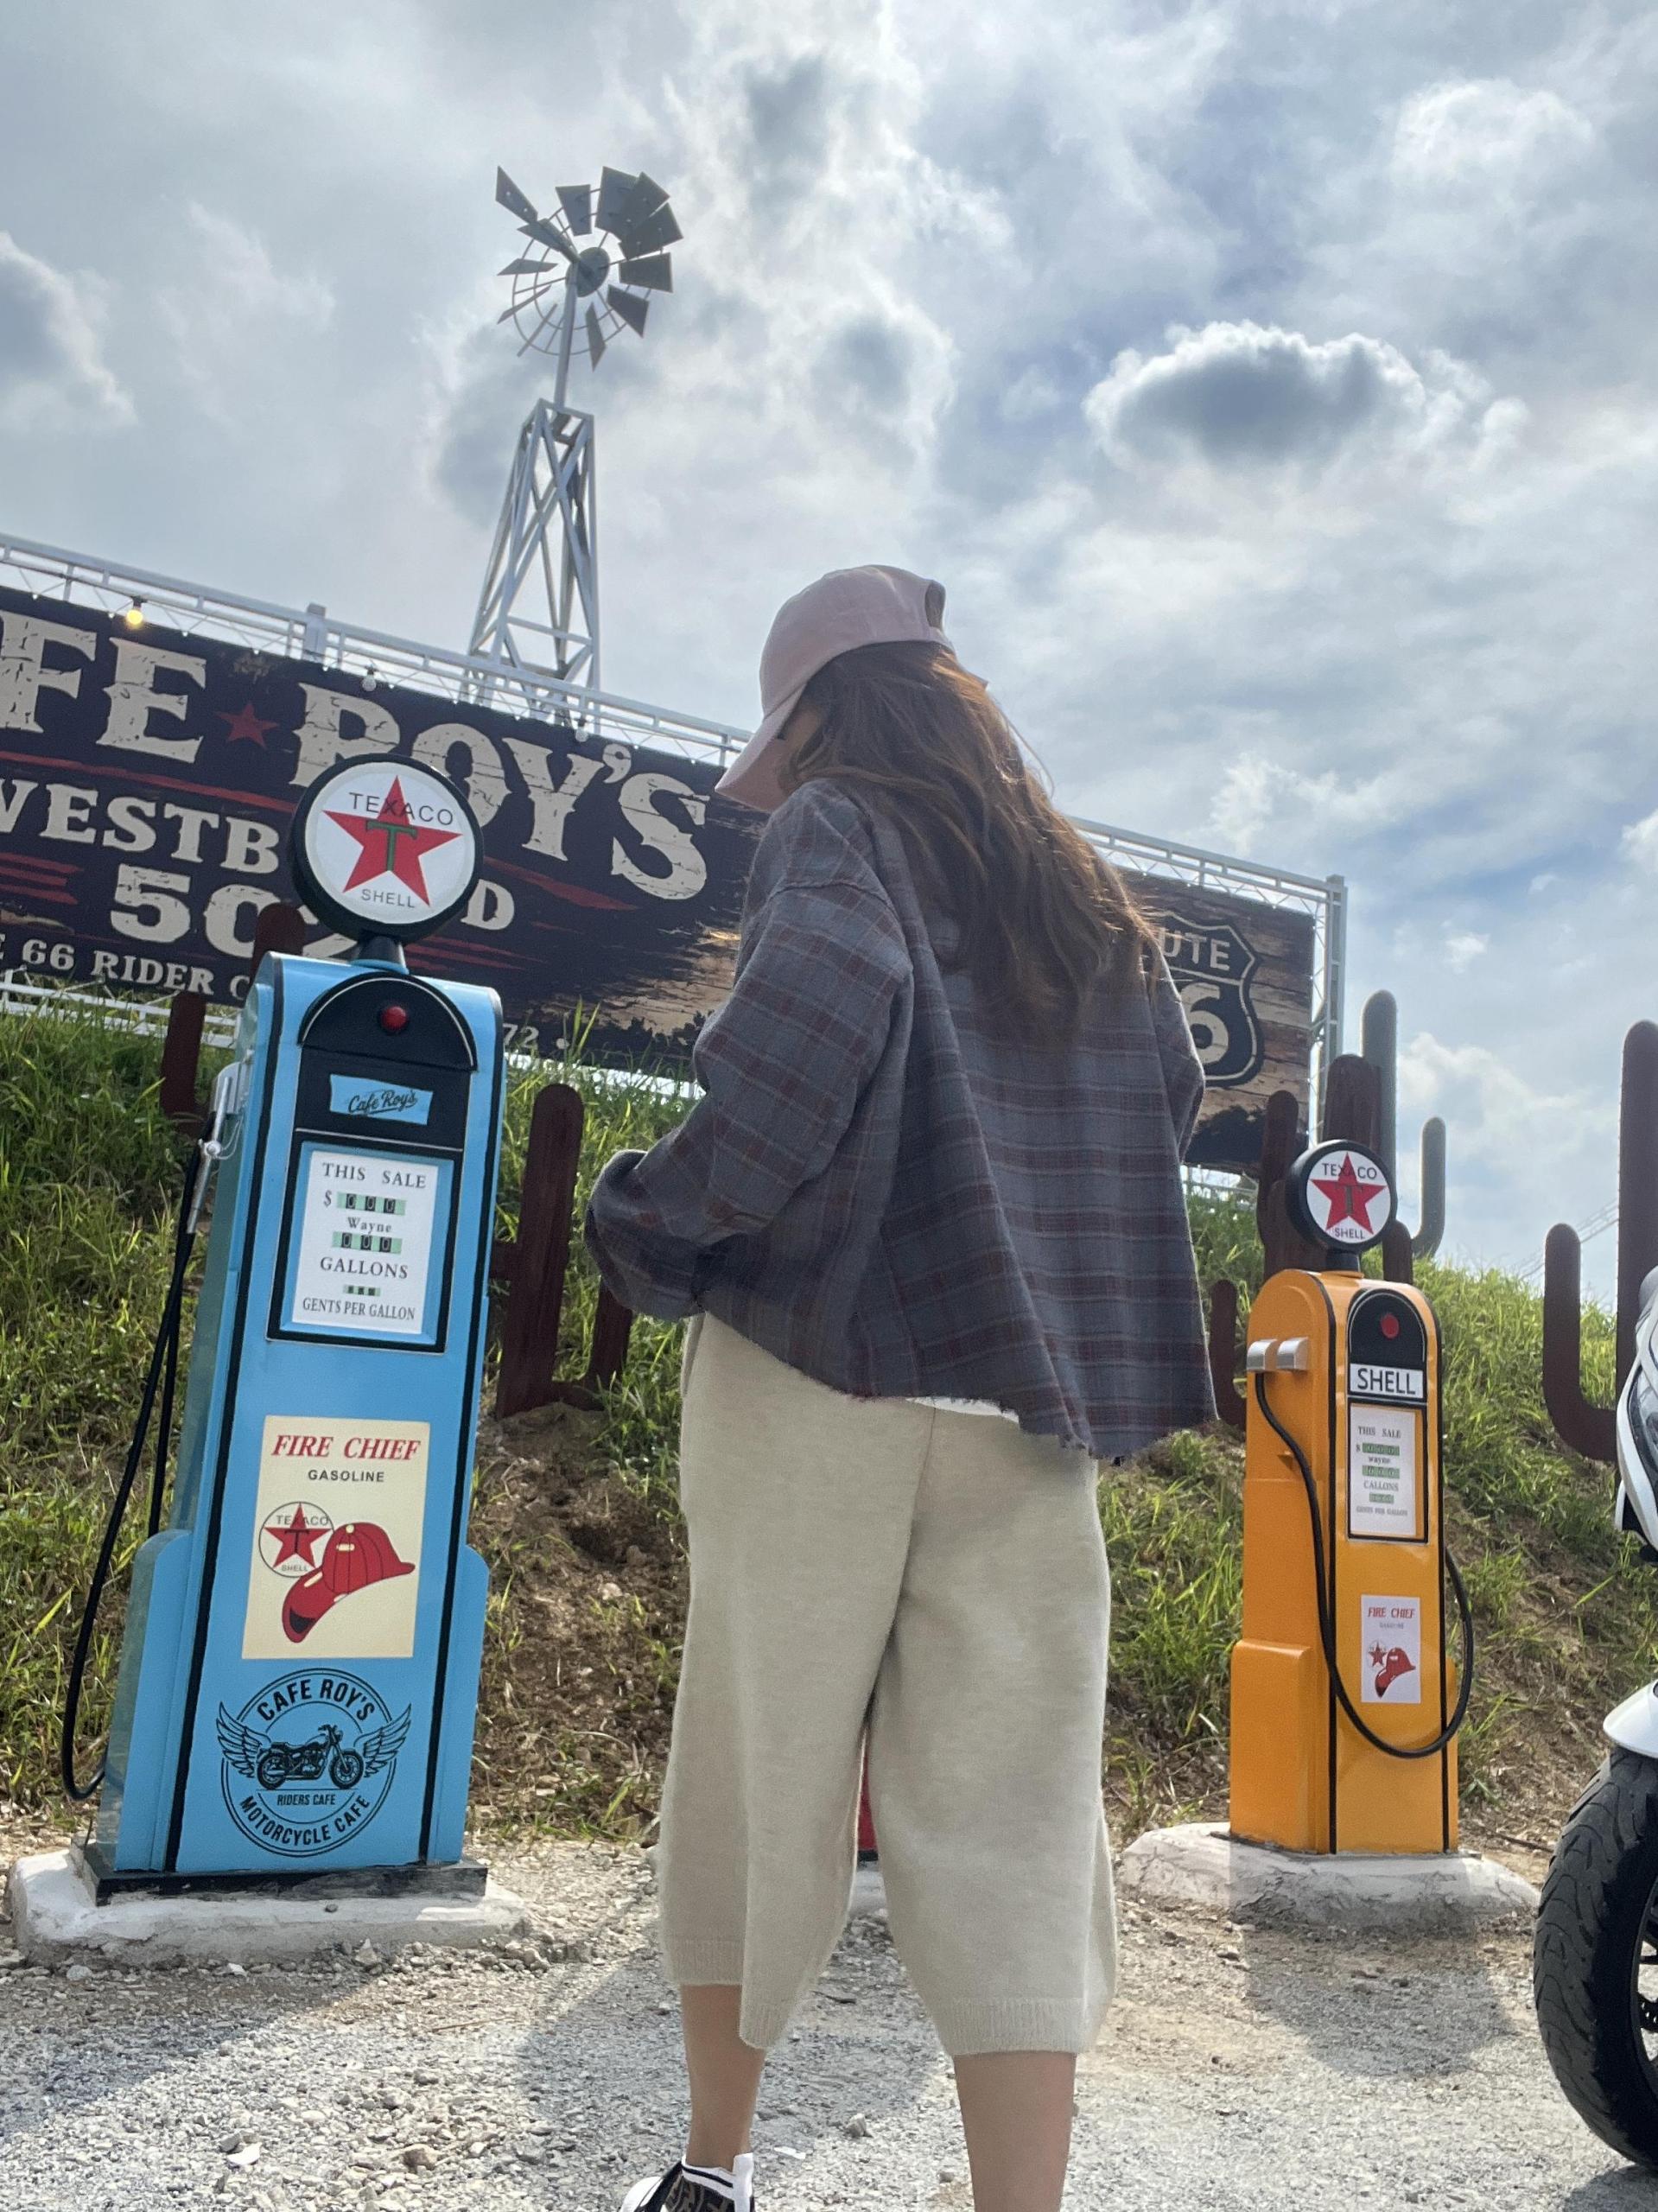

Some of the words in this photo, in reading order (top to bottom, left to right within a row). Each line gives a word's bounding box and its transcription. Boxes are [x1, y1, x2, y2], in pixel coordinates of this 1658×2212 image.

[349, 791, 453, 826] TEXACO
[361, 888, 415, 908] SHELL
[22, 938, 75, 971] 66
[90, 950, 214, 995] RIDER
[322, 1162, 366, 1182] THIS
[382, 1169, 426, 1189] SALE
[347, 1216, 392, 1235] Wayne
[1334, 1227, 1366, 1240] SHELL
[320, 1255, 408, 1280] GALLONS
[344, 1301, 365, 1316] PER
[369, 1304, 416, 1320] GALLON
[1357, 1368, 1416, 1395] SHELL
[271, 1434, 334, 1458] FIRE
[344, 1437, 421, 1460] CHIEF
[308, 1469, 384, 1483] GASOLINE
[257, 1679, 312, 1721] CAFE
[320, 1678, 375, 1721] ROY'S
[276, 1794, 310, 1806] RIDERS
[313, 1794, 336, 1805] CAFE
[239, 1796, 331, 1846] MOTORCYCLE
[334, 1795, 370, 1833] CAFE
